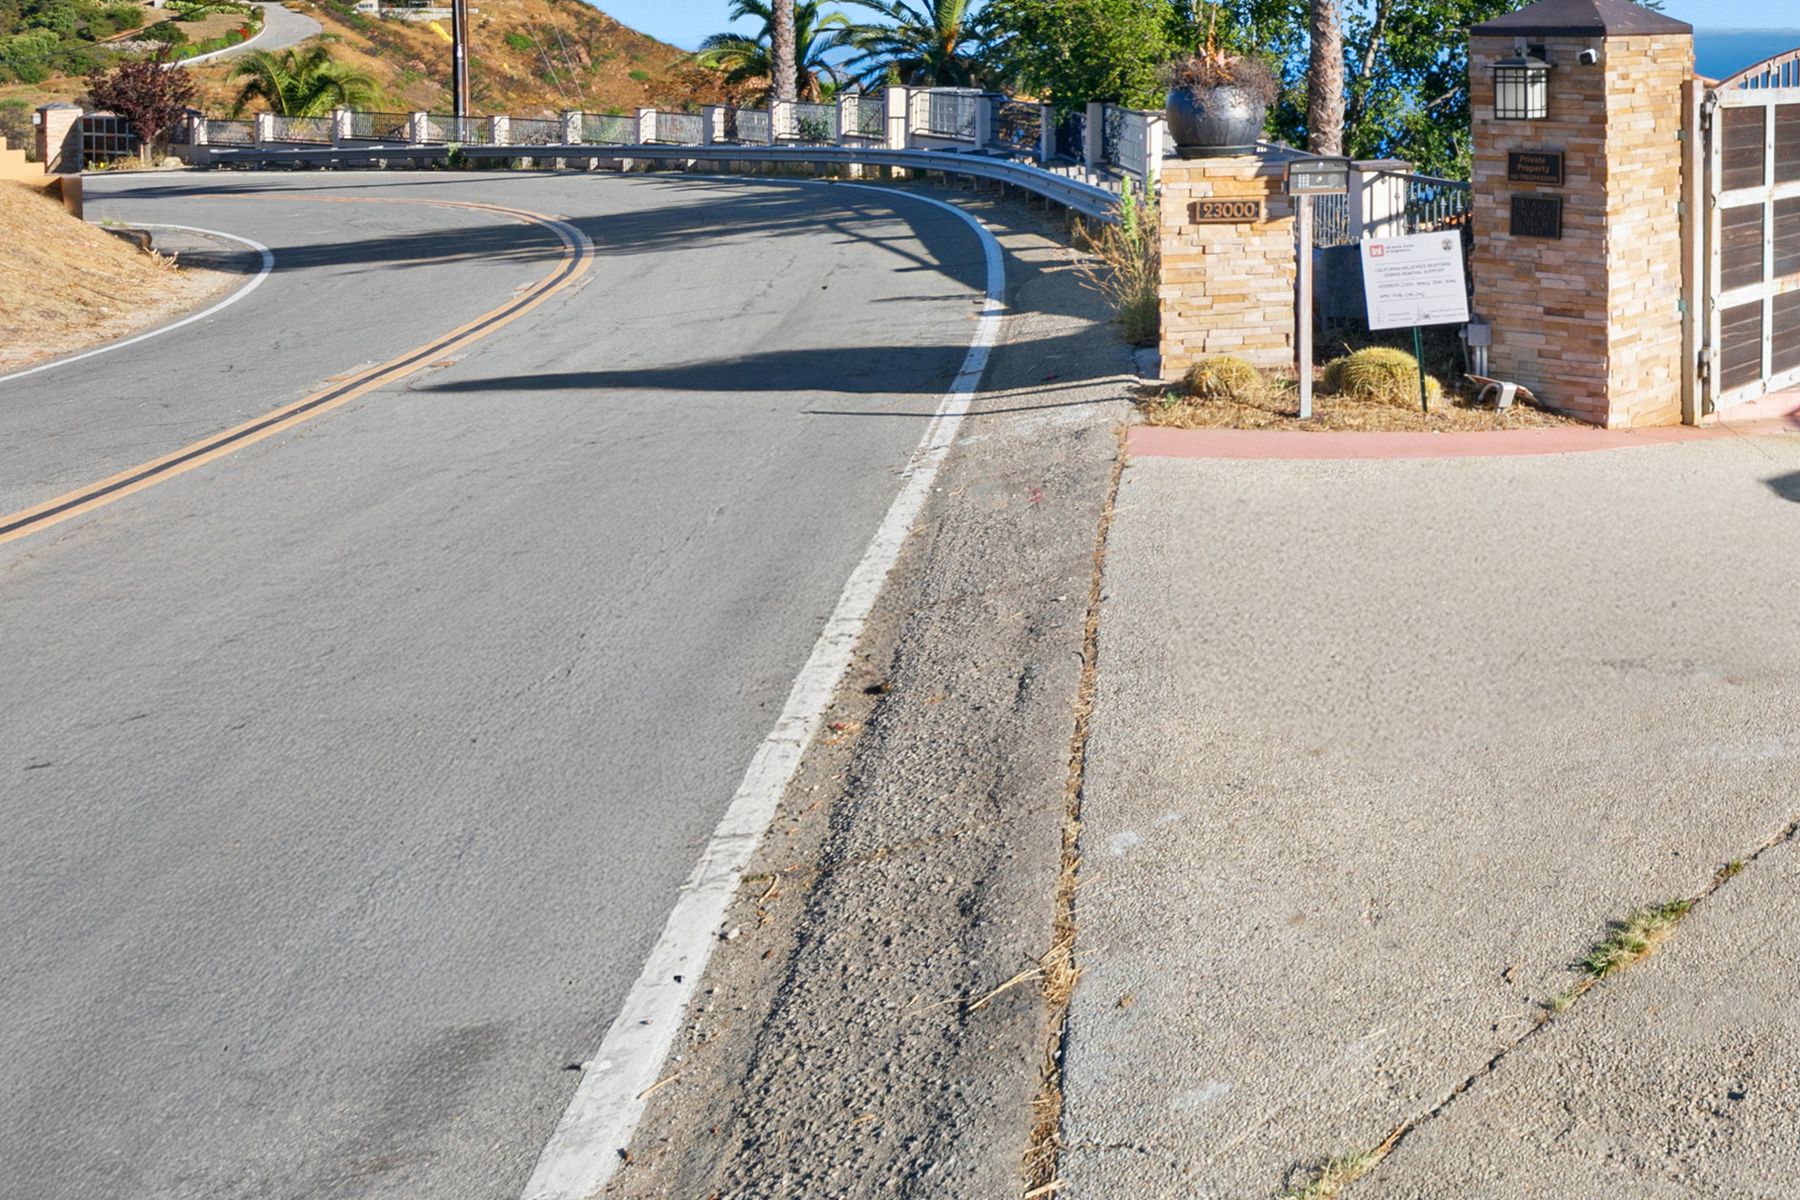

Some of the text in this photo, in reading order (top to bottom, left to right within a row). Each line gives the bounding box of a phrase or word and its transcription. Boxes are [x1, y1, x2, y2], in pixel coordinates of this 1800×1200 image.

[1520, 155, 1546, 164] Private
[1517, 163, 1550, 174] Property
[1203, 202, 1255, 218] 23000
